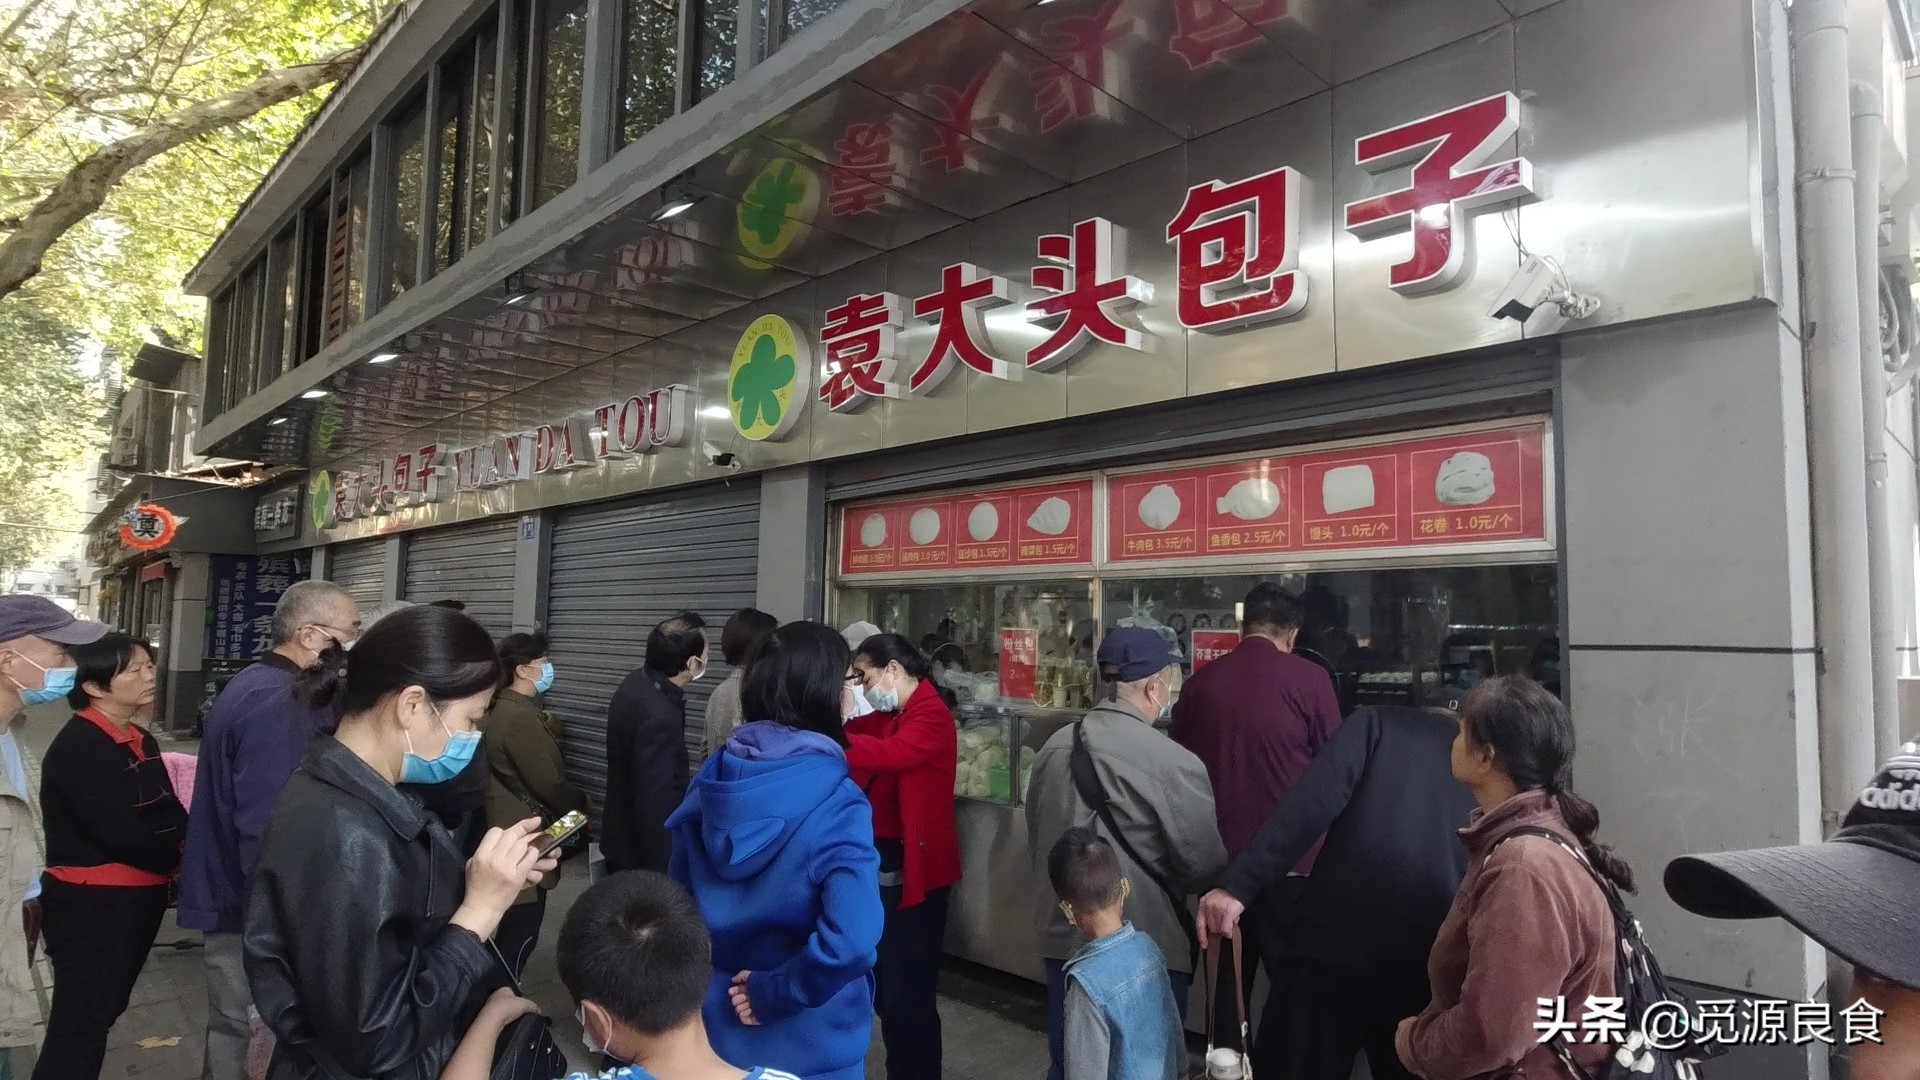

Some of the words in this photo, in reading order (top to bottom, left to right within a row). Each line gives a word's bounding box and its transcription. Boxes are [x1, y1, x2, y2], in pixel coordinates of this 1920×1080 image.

[819, 91, 1533, 413] 袁大头包子
[449, 432, 531, 492] YUAN
[533, 417, 588, 475] DA
[594, 384, 687, 459] TOU
[332, 444, 447, 519] 袁大头包子
[134, 513, 159, 538] 奠
[1309, 525, 1334, 541] 馒头
[1340, 521, 1389, 538] 1.0元/个
[1419, 518, 1448, 534] 花卷
[1455, 514, 1514, 531] 1.0元/个
[1156, 536, 1193, 549] 3.5元/个
[1243, 529, 1286, 544] 2.5元/个
